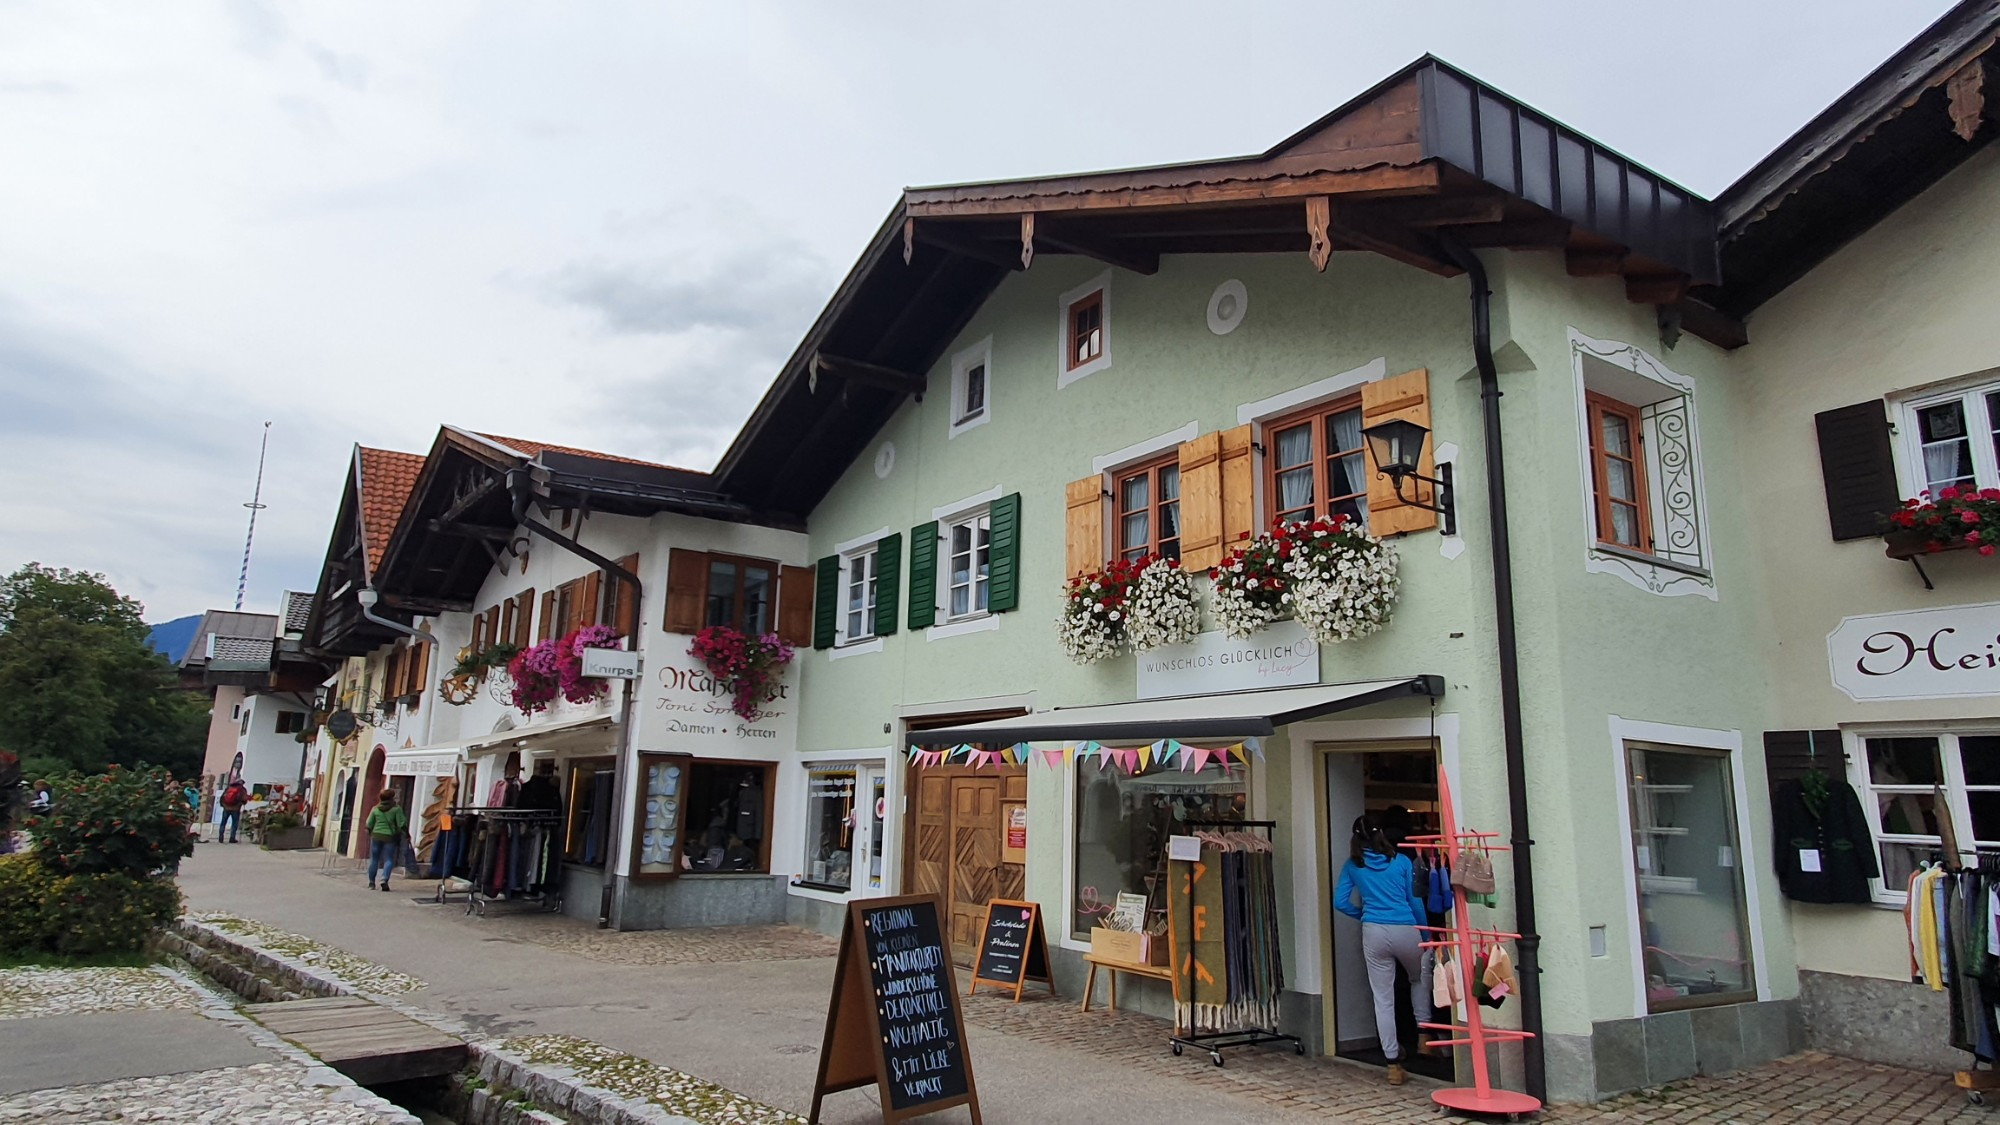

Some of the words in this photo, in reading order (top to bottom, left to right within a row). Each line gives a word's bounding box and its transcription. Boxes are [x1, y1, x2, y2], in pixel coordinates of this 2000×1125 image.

[1146, 655, 1213, 673] WUNSCHLOS
[1220, 645, 1292, 665] GLÜCKLICH
[1857, 627, 2000, 676] Hei
[589, 663, 634, 676] Knirps
[656, 697, 697, 712] Toni
[703, 700, 786, 723] Sprger
[666, 719, 715, 734] Damen
[736, 723, 777, 739] Herren
[871, 908, 918, 937] REGIONAL
[877, 945, 944, 978] MANUFAKTUREN
[883, 972, 939, 996] WUNDERSCHÖNE
[885, 991, 948, 1022] DEKOARTIKEL
[892, 1056, 903, 1082] &
[904, 1076, 942, 1099] VERPACKT
